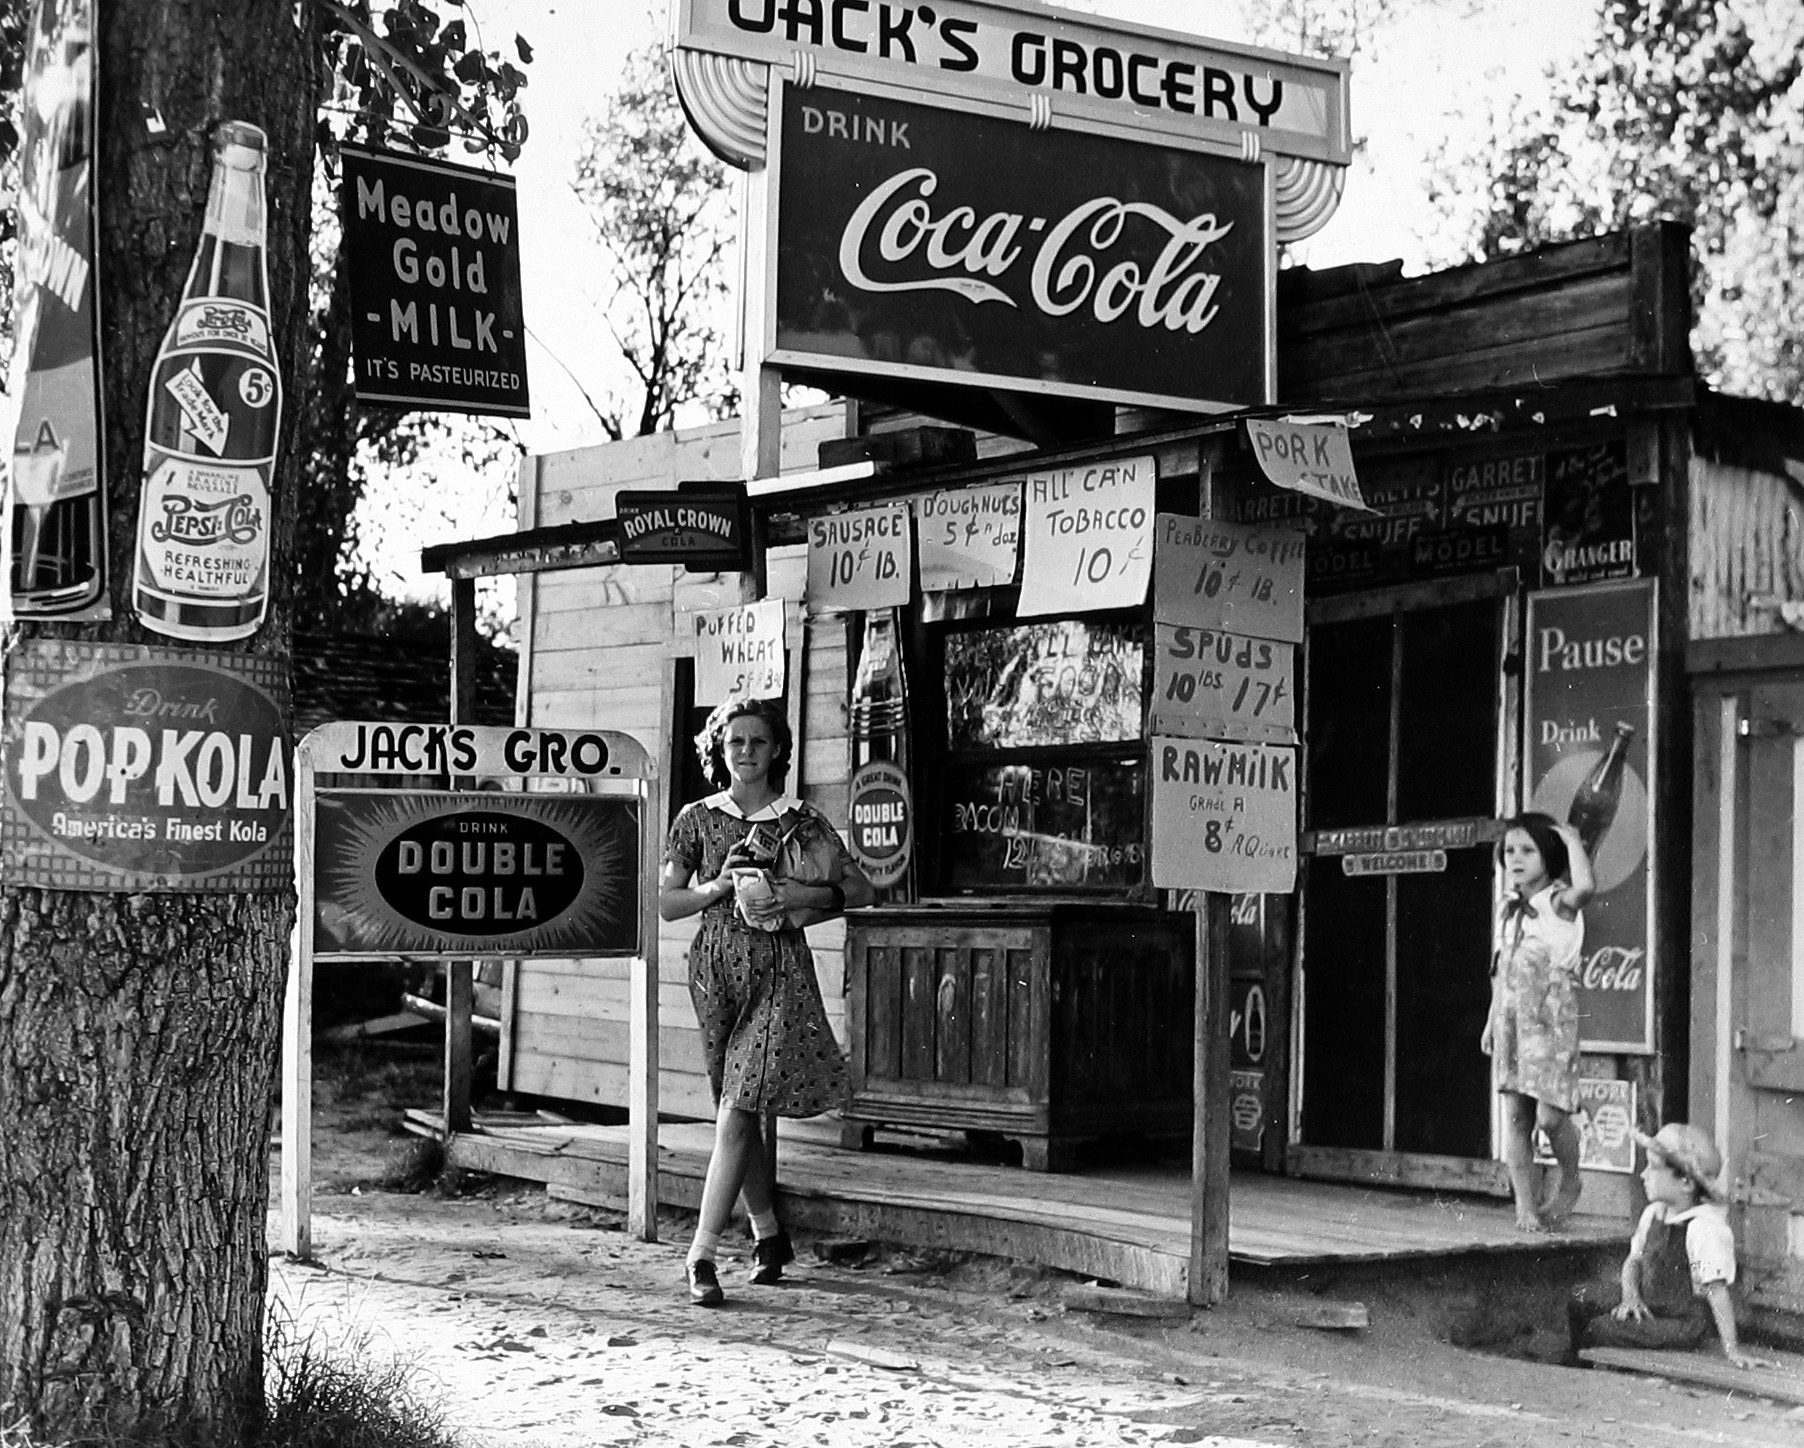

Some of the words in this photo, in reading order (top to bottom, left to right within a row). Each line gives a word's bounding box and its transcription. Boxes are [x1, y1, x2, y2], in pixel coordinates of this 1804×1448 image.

[729, 0, 979, 72] JACK'S
[1011, 32, 1283, 127] GROCERY
[802, 107, 910, 149] DRINK
[357, 175, 509, 245] Meadow
[393, 238, 488, 294] Gold
[839, 168, 1234, 334] Coca-Cola
[246, 372, 272, 404] 5¢
[367, 357, 399, 379] IT'S
[410, 362, 520, 390] PASTEURIZED
[1256, 432, 1330, 467] PORK
[623, 508, 675, 539] ROYAL
[677, 508, 732, 538] CROWN
[813, 513, 903, 548] SAUSAGE
[662, 537, 696, 547] COLA
[1415, 534, 1503, 565] MODEL
[1544, 540, 1632, 573] GRANGER
[163, 565, 249, 585] HEALTHFUL
[165, 550, 251, 571] REFRESHING
[1312, 548, 1375, 573] ODEL
[696, 611, 756, 636] PUFFED
[1538, 626, 1645, 673] Pause
[123, 688, 219, 724] Drink
[1541, 719, 1601, 745] Drink
[340, 724, 478, 773] JACK'S
[504, 730, 622, 775] GRO.
[1162, 745, 1224, 787] RAW
[855, 801, 904, 825] DOUBLE
[1233, 796, 1244, 812] A
[52, 812, 157, 841] America's
[165, 817, 223, 841] Finest
[229, 820, 268, 842] Kola
[459, 821, 509, 834] DRINK
[862, 825, 899, 848] COLA
[398, 840, 566, 876] DOUBLE
[428, 886, 538, 920] COLA
